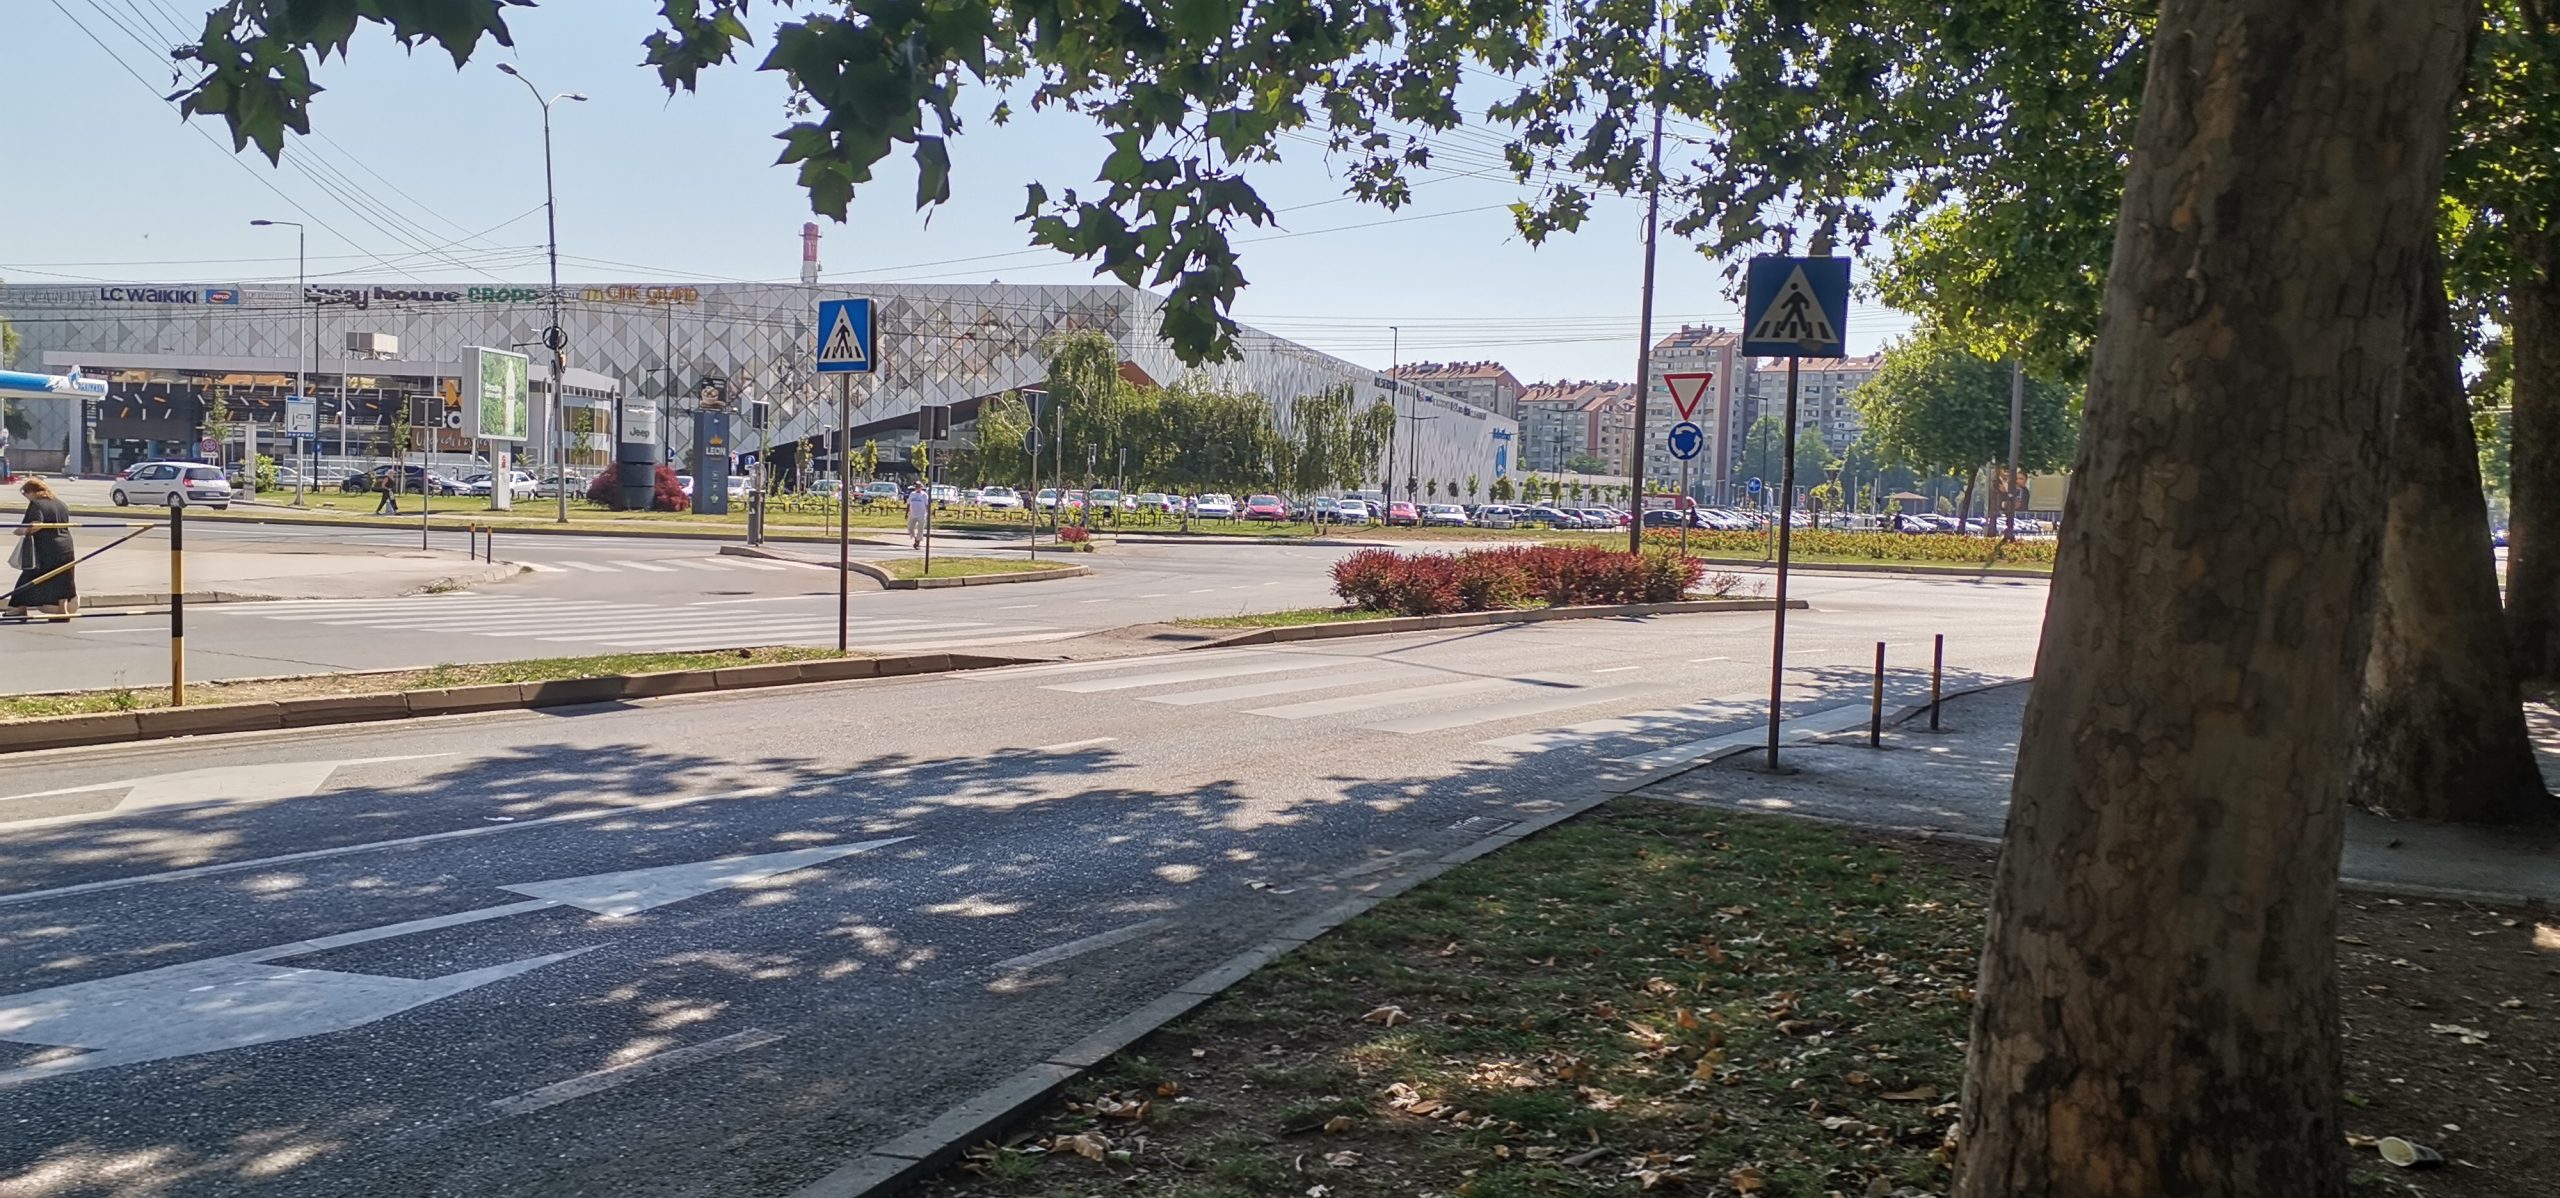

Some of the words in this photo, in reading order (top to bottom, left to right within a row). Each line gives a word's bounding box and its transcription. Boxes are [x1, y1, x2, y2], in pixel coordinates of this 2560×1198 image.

[100, 287, 123, 301] LC
[630, 427, 650, 439] Jeep
[705, 447, 727, 456] LEON
